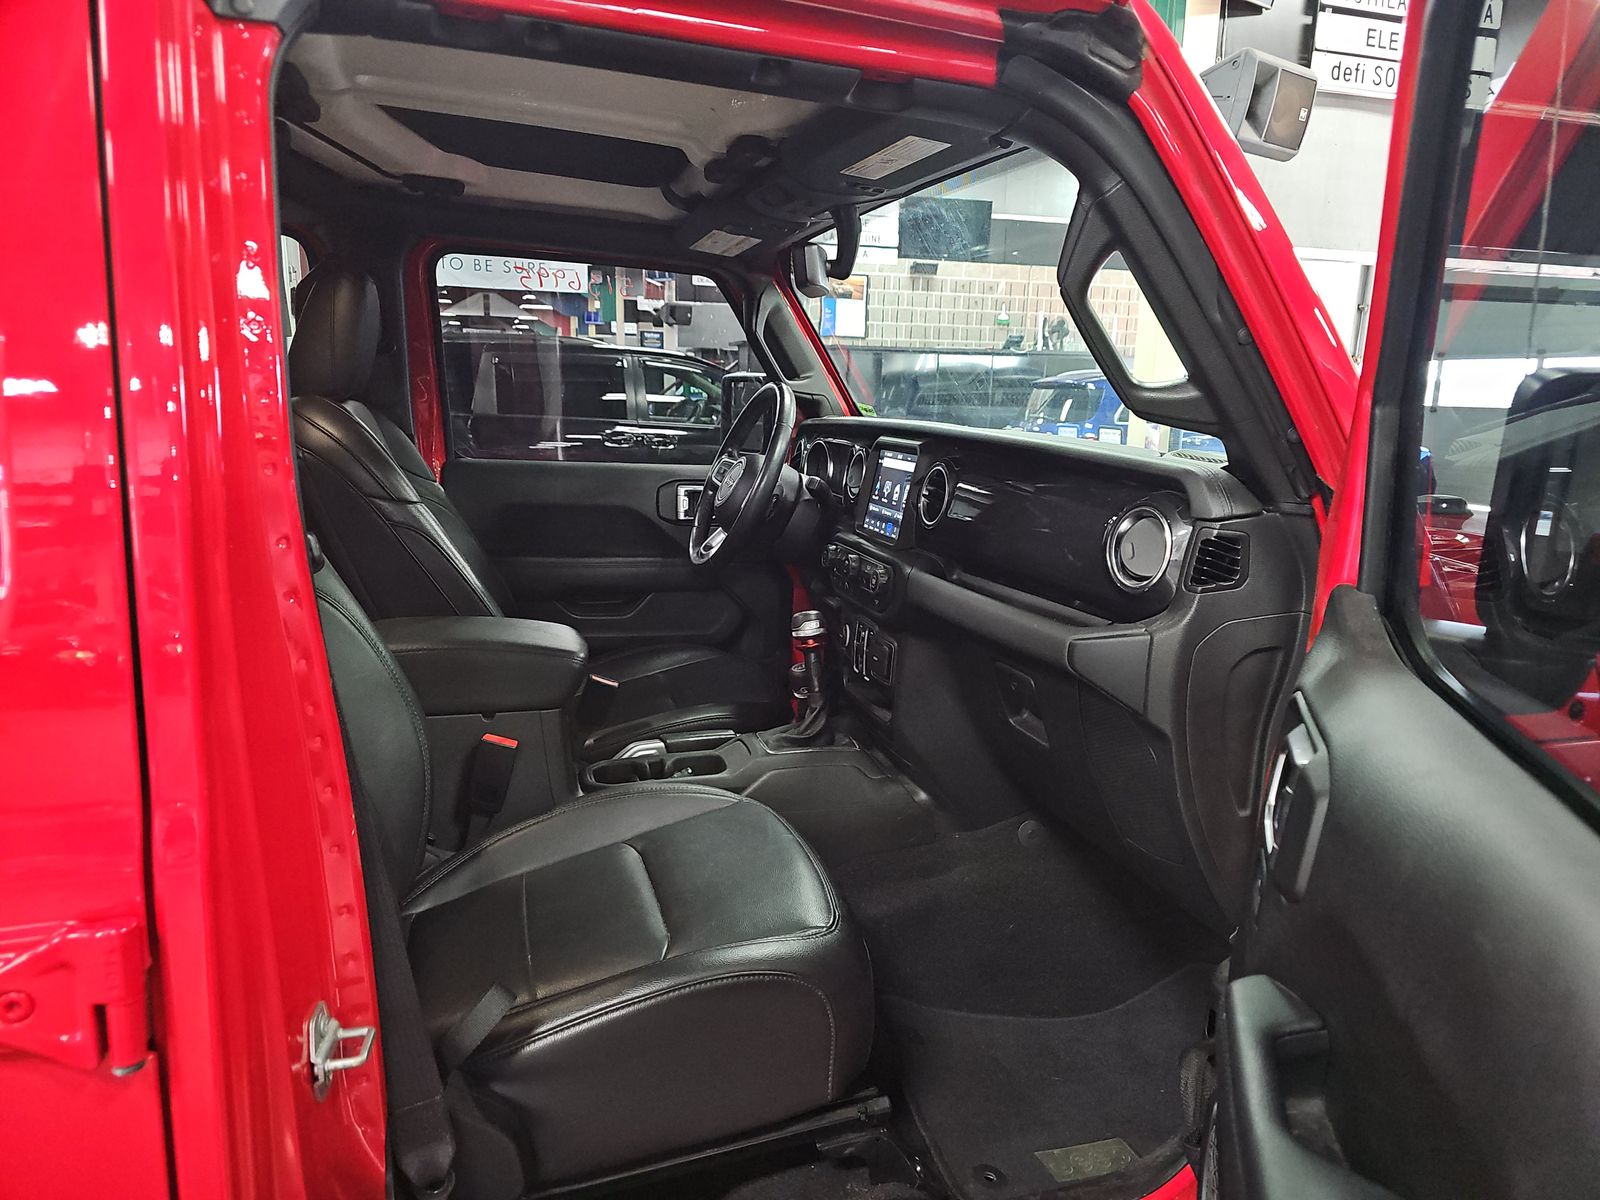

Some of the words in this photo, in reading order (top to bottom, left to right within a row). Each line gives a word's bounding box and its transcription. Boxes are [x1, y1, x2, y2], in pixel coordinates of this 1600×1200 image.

[1331, 60, 1366, 84] defi
[440, 257, 464, 270] TO
[473, 258, 493, 272] BE
